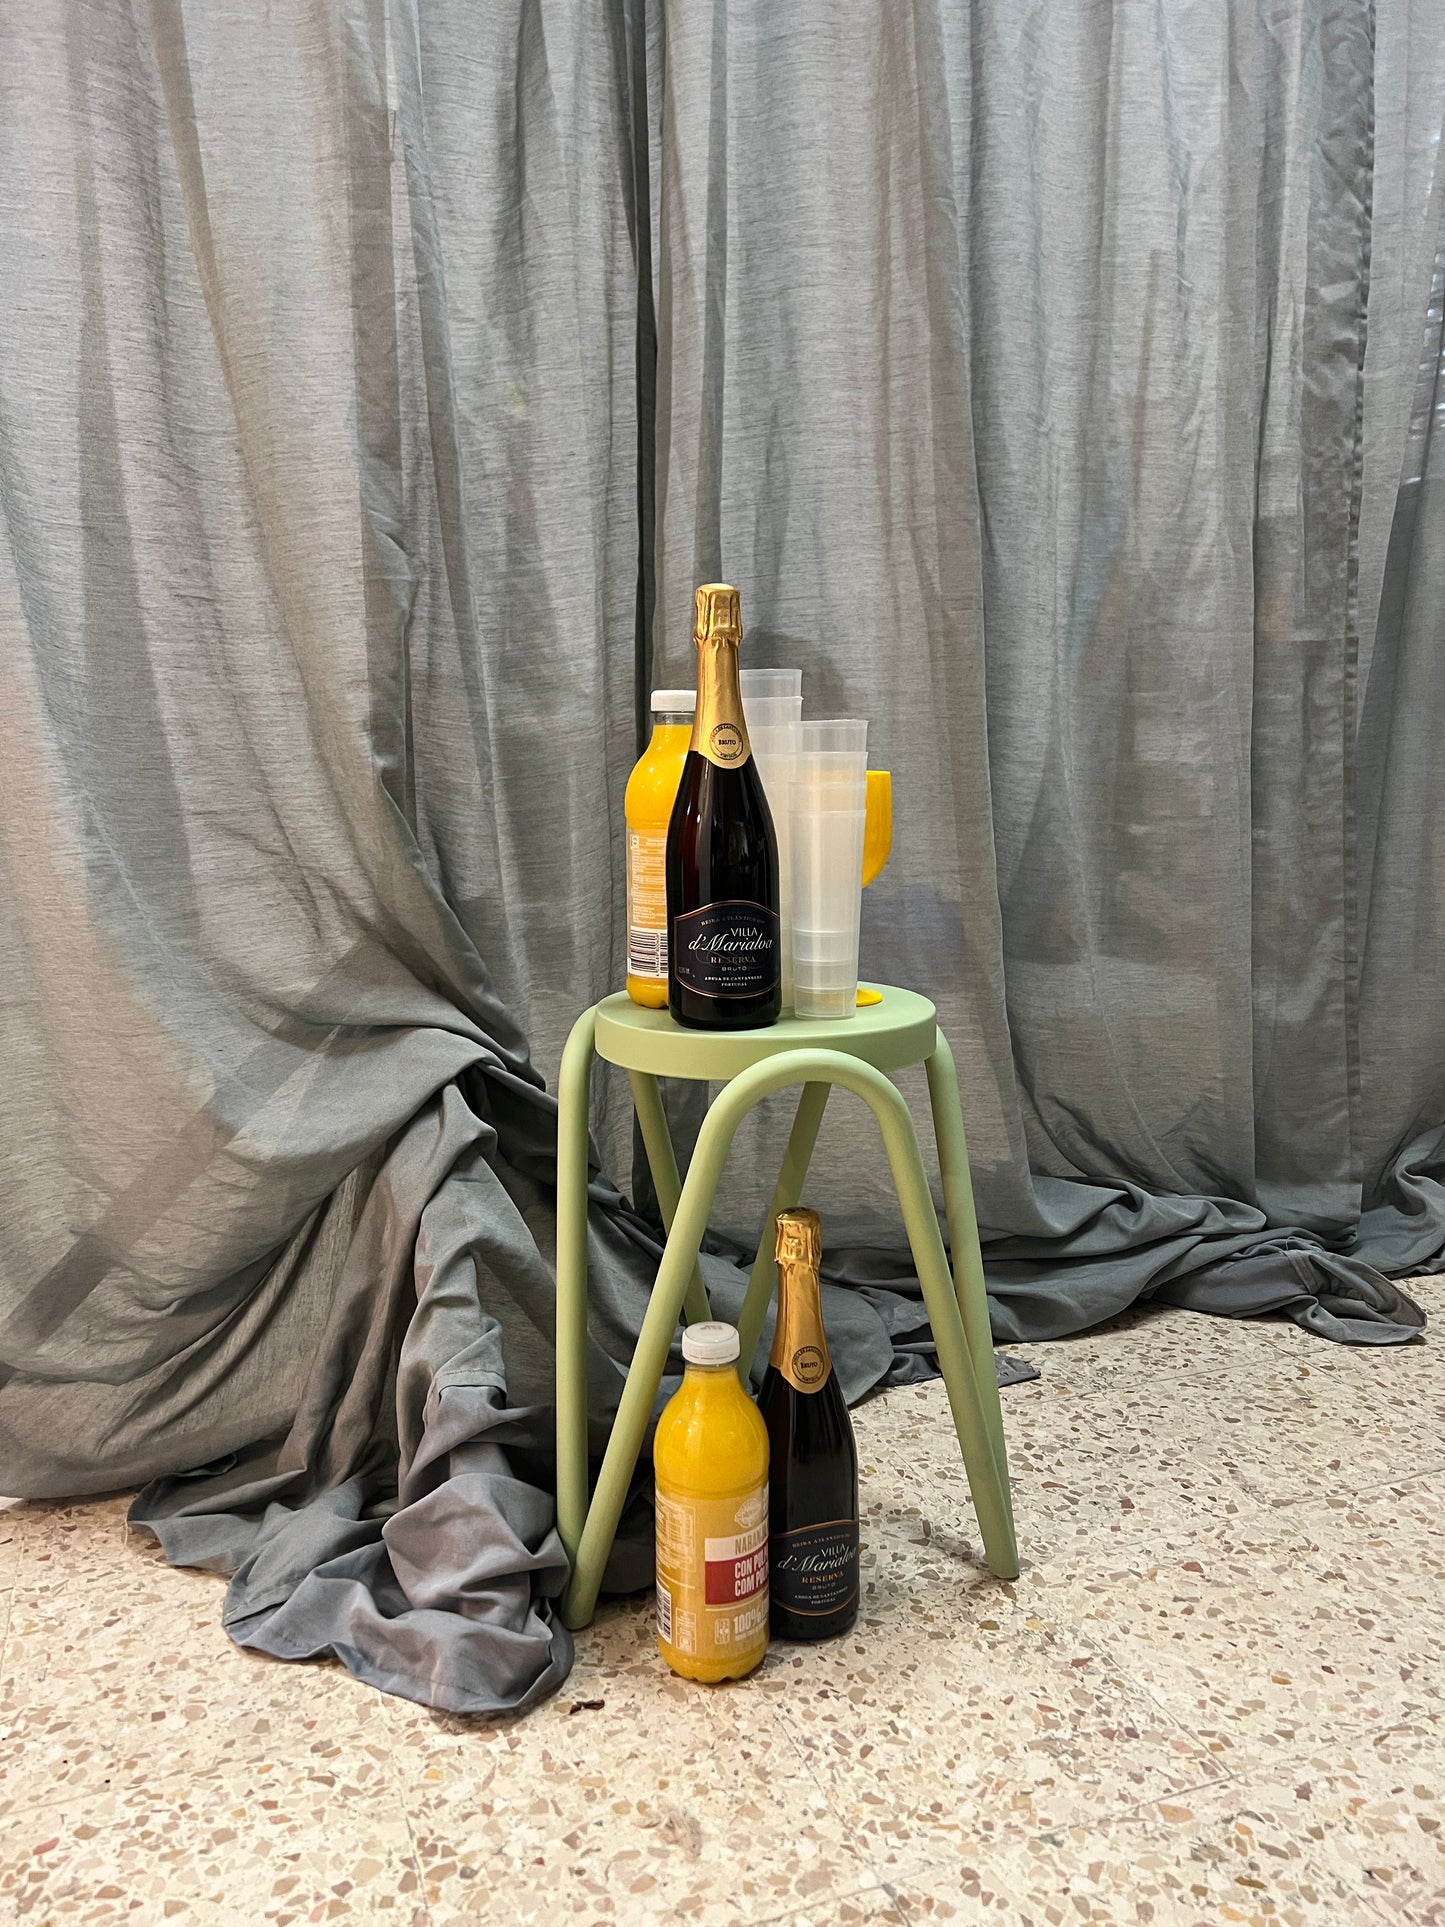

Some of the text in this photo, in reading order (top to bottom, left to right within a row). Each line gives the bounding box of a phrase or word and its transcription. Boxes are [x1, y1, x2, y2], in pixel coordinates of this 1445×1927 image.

[730, 927, 758, 937] VILLA
[688, 933, 772, 951] d'Marialva
[710, 955, 756, 964] RESERVA
[778, 1545, 857, 1572] d'Marialva
[821, 1543, 846, 1557] VILLA
[735, 1557, 752, 1579] CON
[802, 1571, 844, 1584] RESERVA
[735, 1577, 754, 1597] COM
[734, 1604, 762, 1635] 100%
